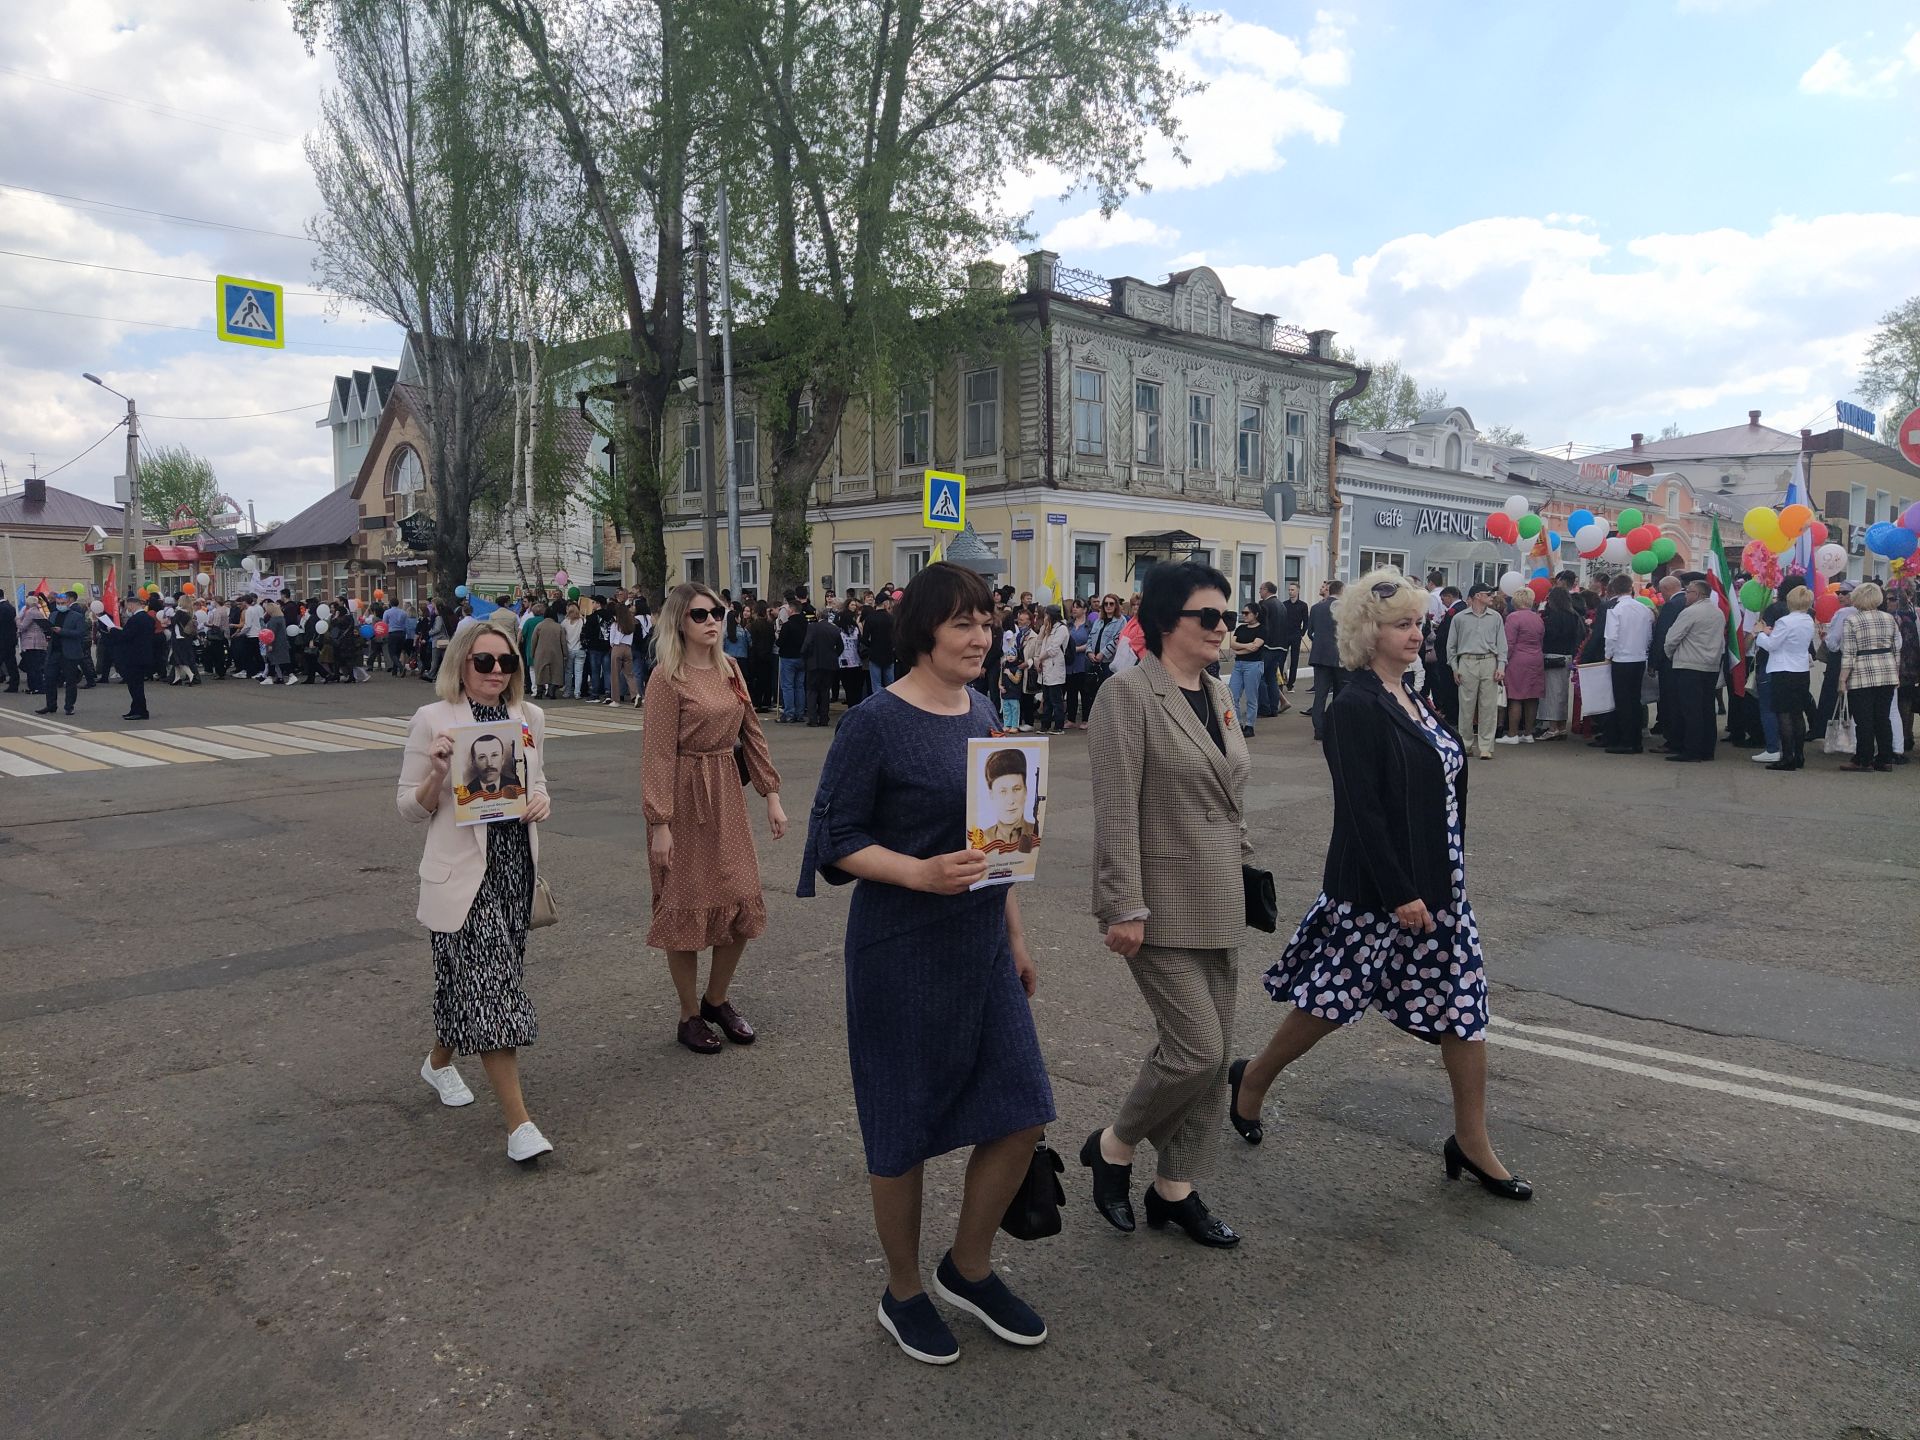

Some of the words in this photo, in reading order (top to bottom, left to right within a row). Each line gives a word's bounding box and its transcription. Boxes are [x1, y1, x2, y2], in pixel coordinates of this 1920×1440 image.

[1836, 400, 1876, 435] SAMSUNG
[1579, 463, 1609, 482] АПТЕКА
[1378, 508, 1403, 527] café
[1415, 508, 1480, 540] AVENUE
